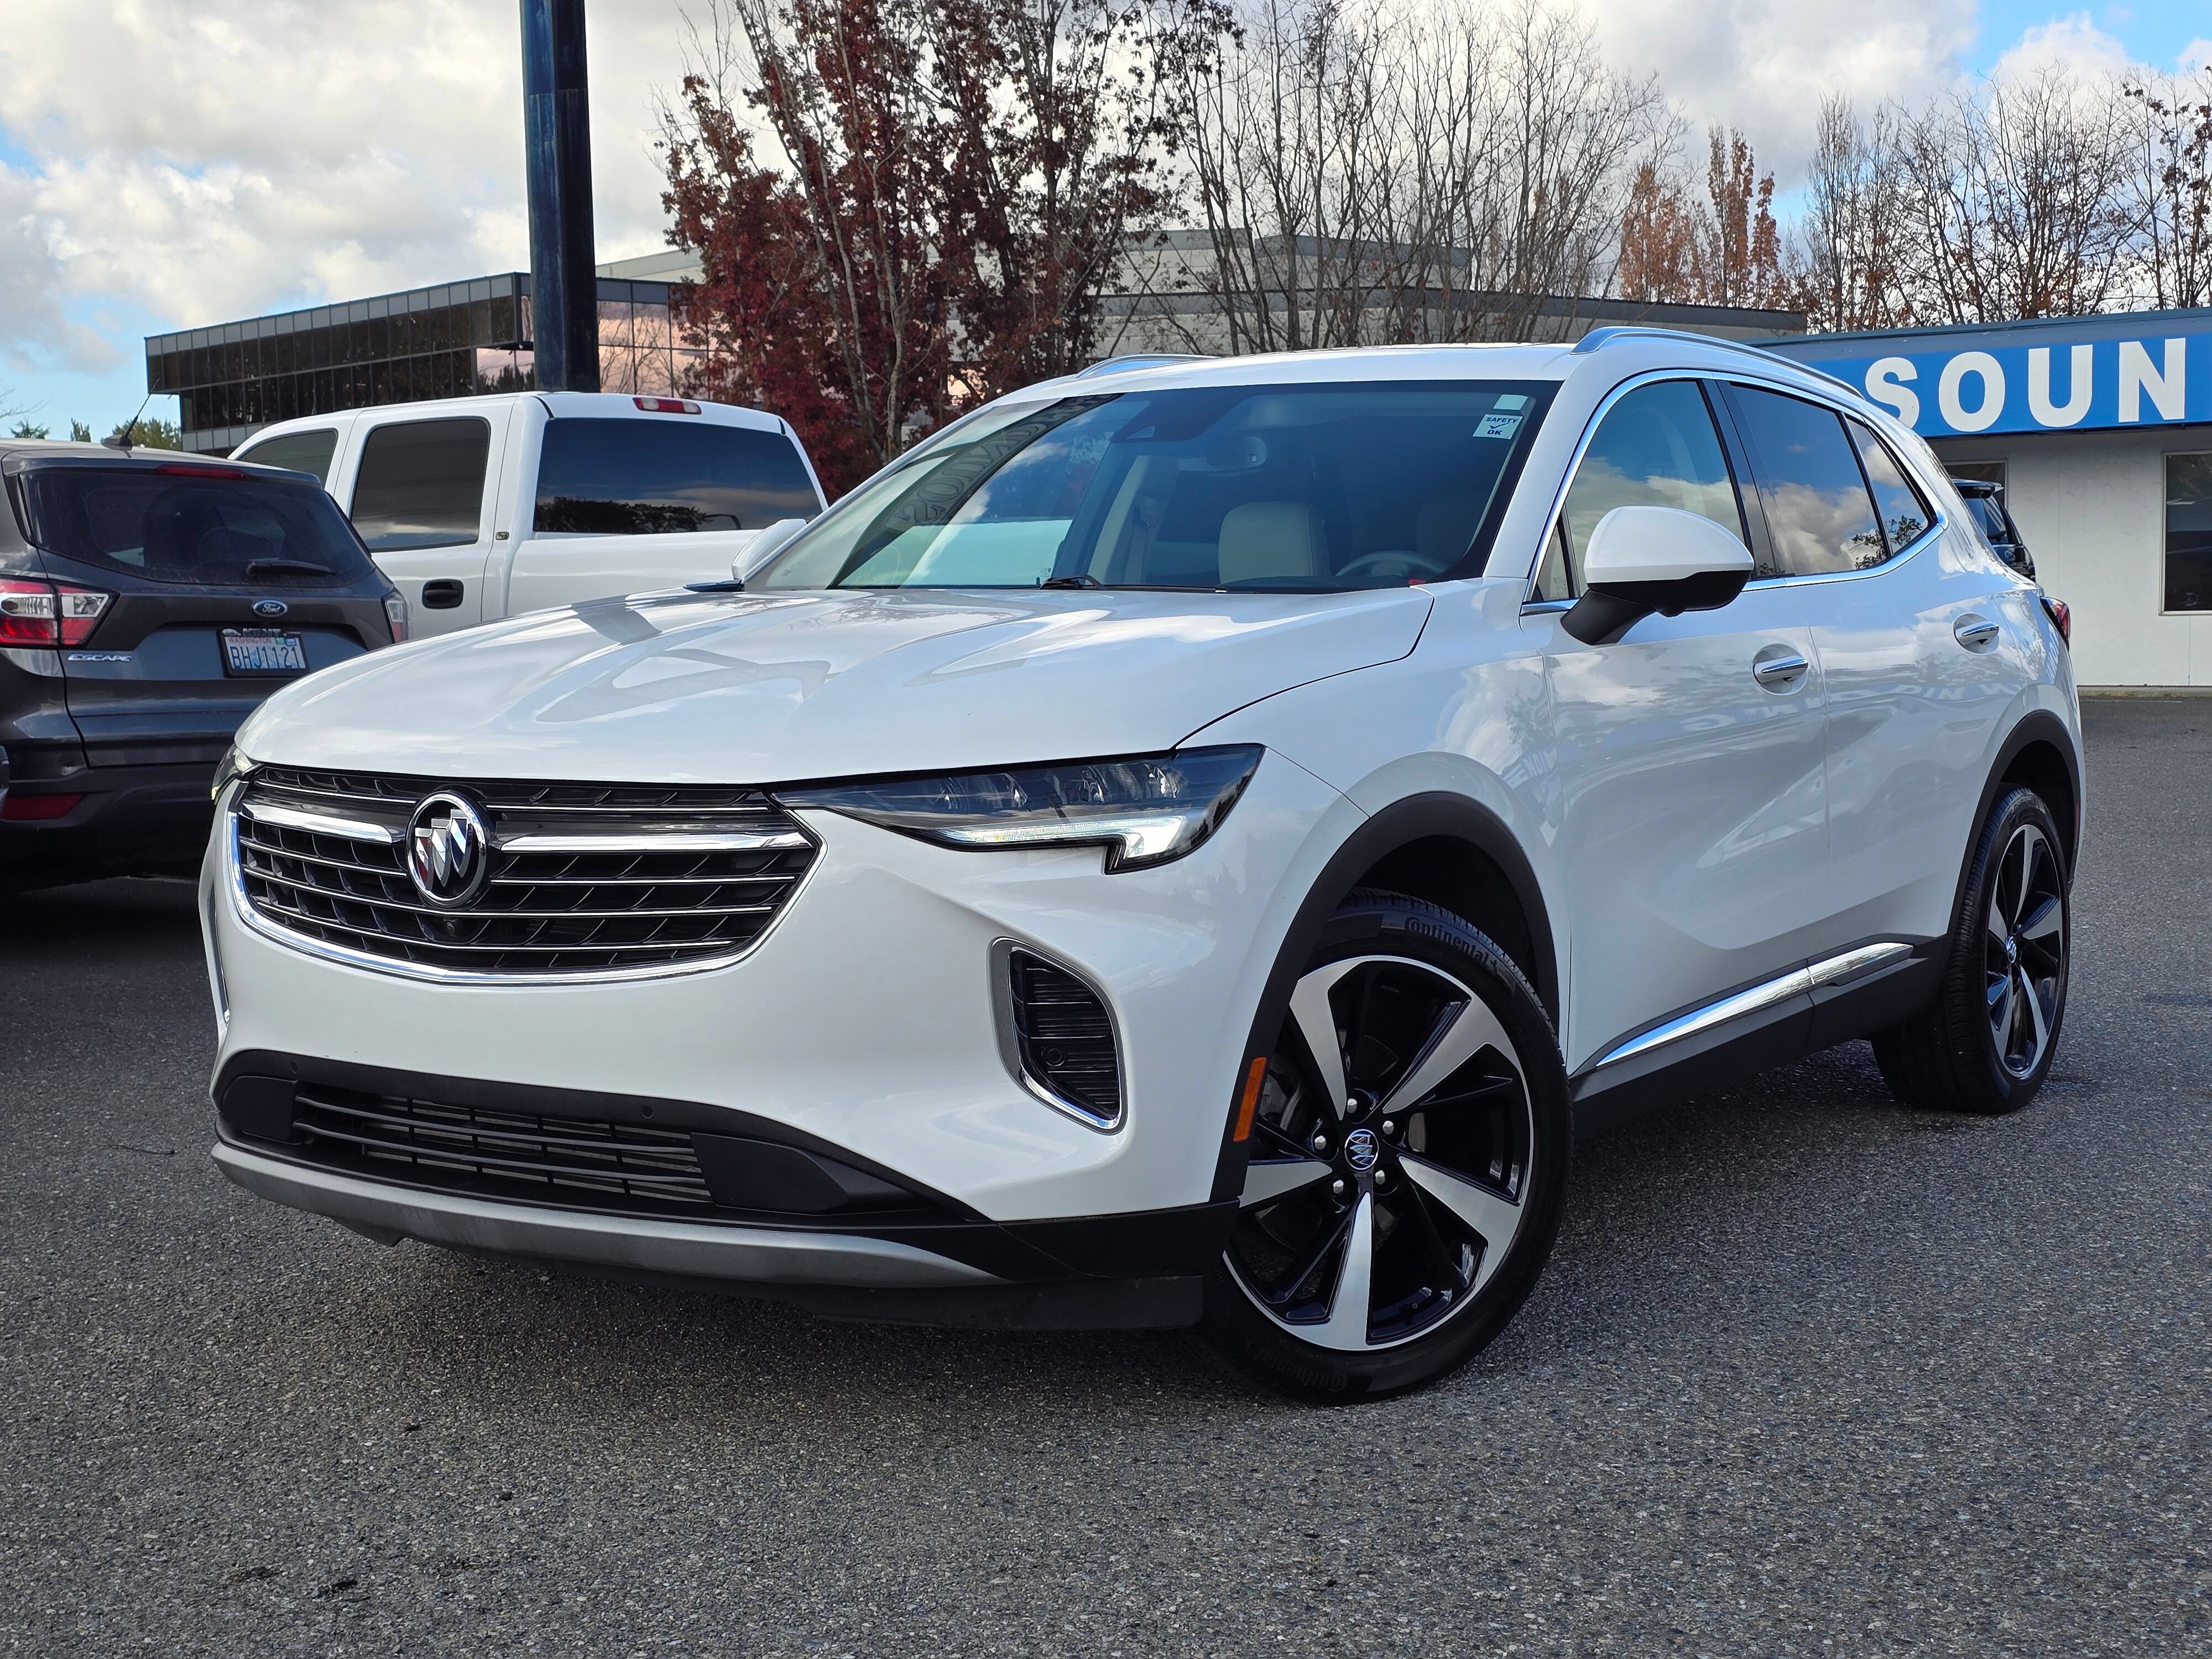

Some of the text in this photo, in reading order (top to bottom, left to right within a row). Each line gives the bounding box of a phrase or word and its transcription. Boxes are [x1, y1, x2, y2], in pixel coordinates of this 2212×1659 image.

[1865, 338, 2186, 432] SOUN
[262, 603, 280, 613] Ford
[67, 654, 132, 662] ESCAPE
[229, 646, 300, 669] BHJ1121
[1404, 917, 1489, 965] Continental
